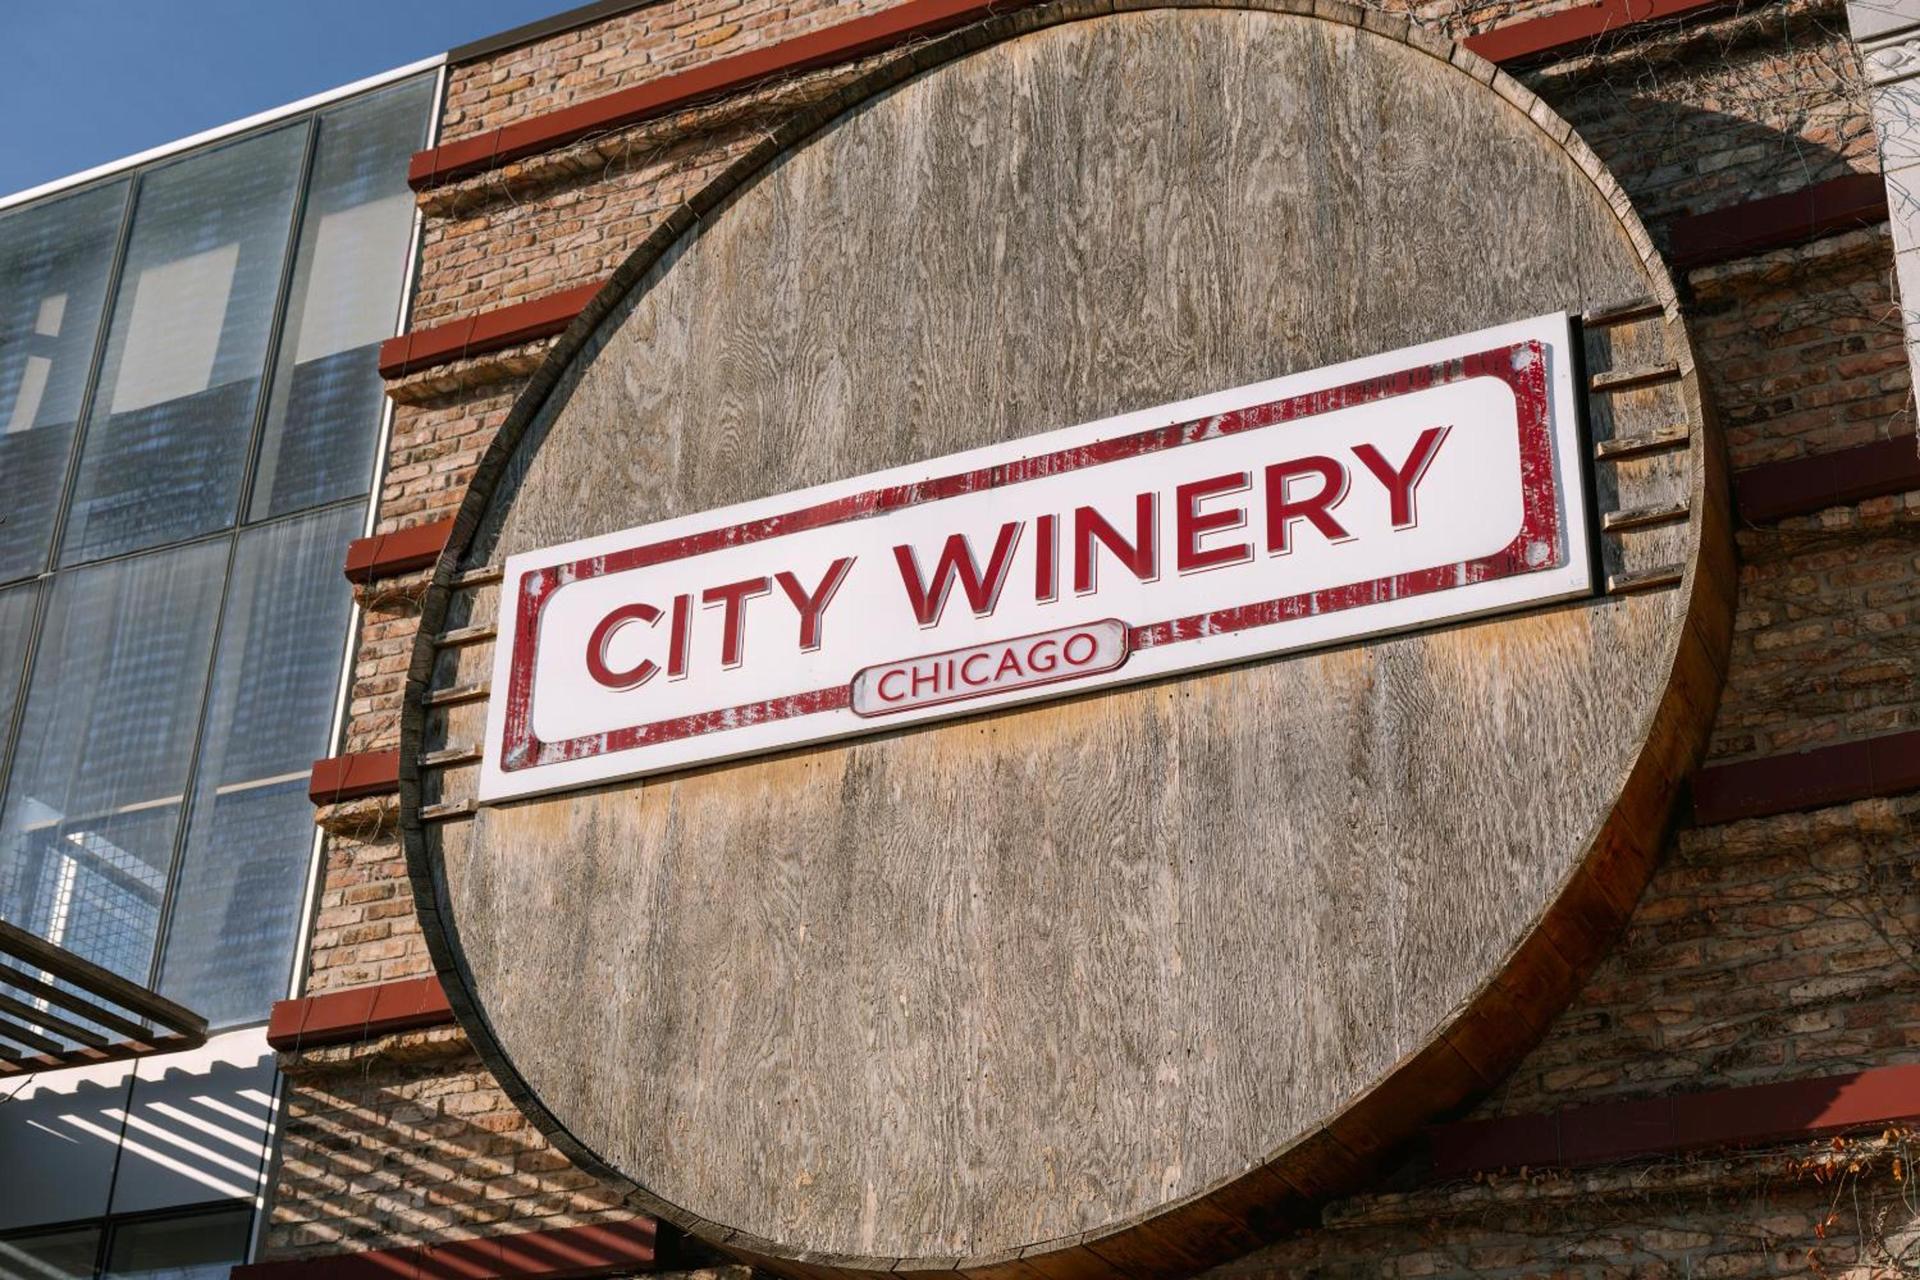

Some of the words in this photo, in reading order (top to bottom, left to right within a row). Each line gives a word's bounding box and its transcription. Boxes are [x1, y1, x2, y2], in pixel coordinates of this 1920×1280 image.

[586, 556, 858, 692] CITY
[892, 425, 1453, 629] WINERY
[877, 632, 1098, 702] CHICAGO
